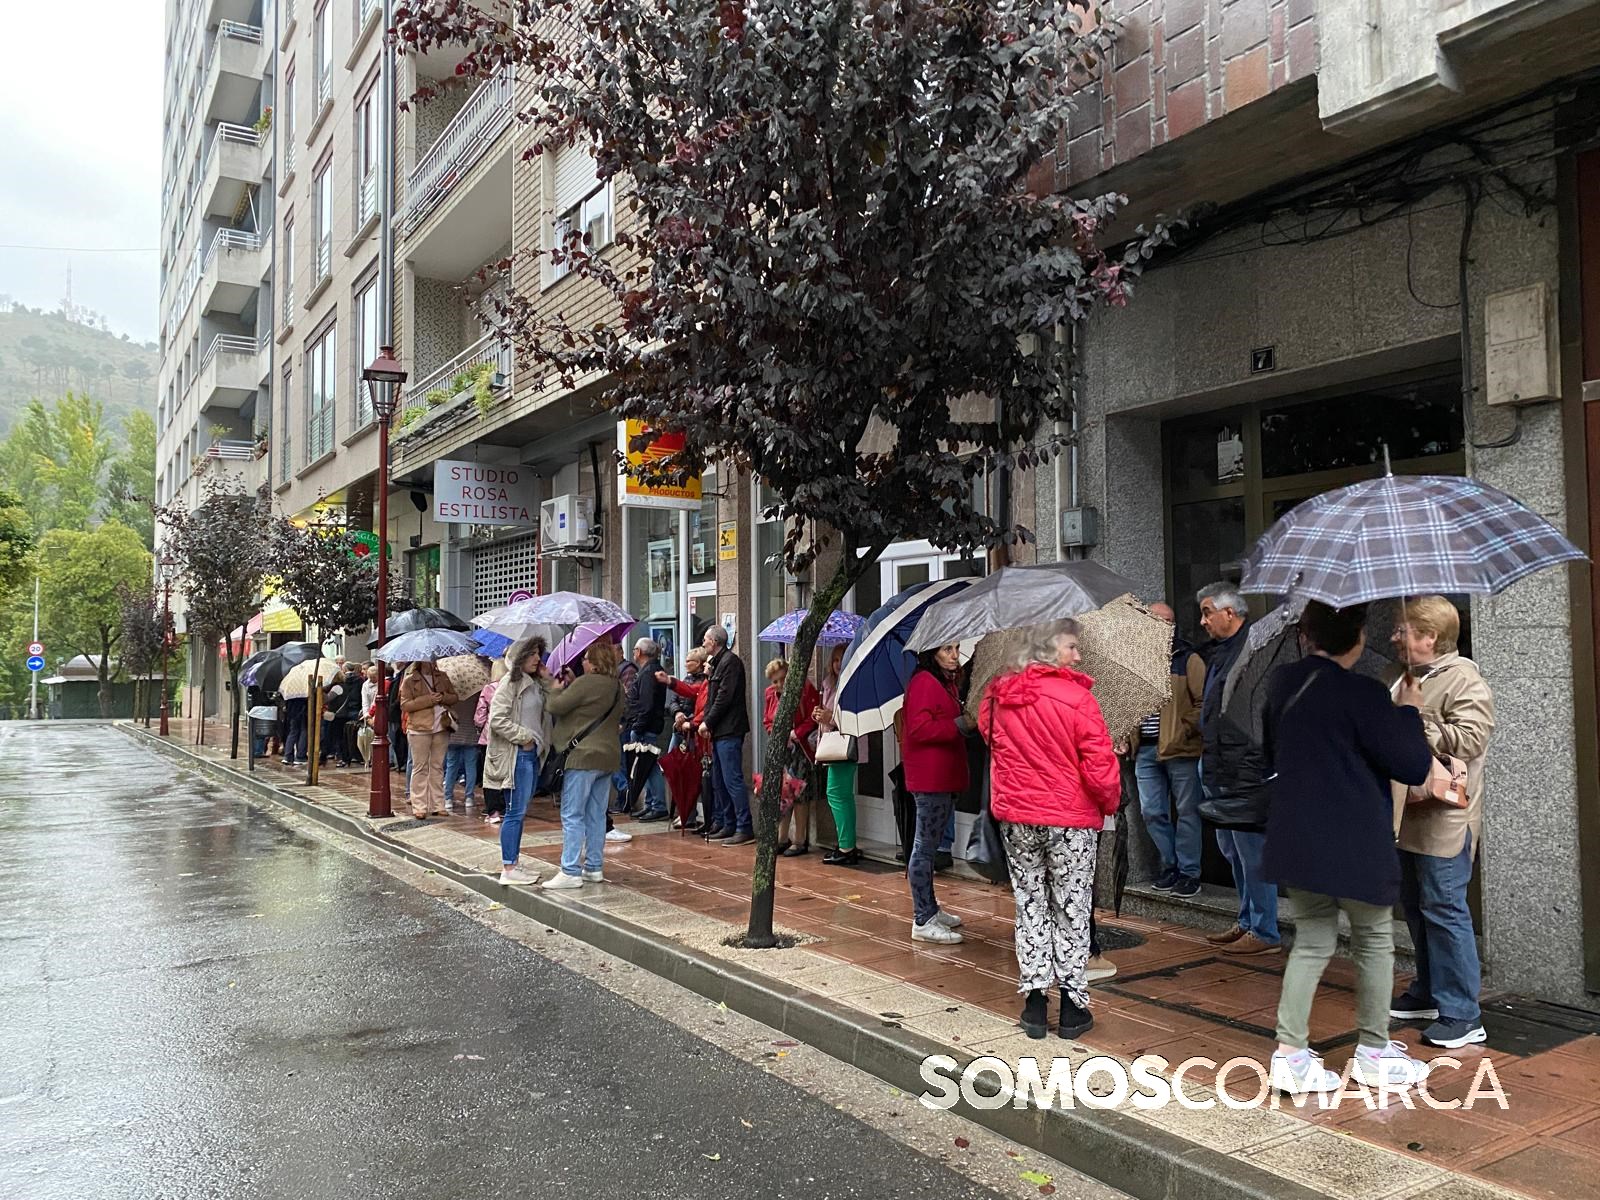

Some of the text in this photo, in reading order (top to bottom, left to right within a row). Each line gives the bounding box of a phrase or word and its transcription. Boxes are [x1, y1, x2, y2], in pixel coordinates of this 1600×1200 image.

[1257, 352, 1266, 368] 7
[451, 466, 519, 485] STUDIO
[462, 485, 508, 502] ROSA
[439, 502, 529, 520] ESTILISTA
